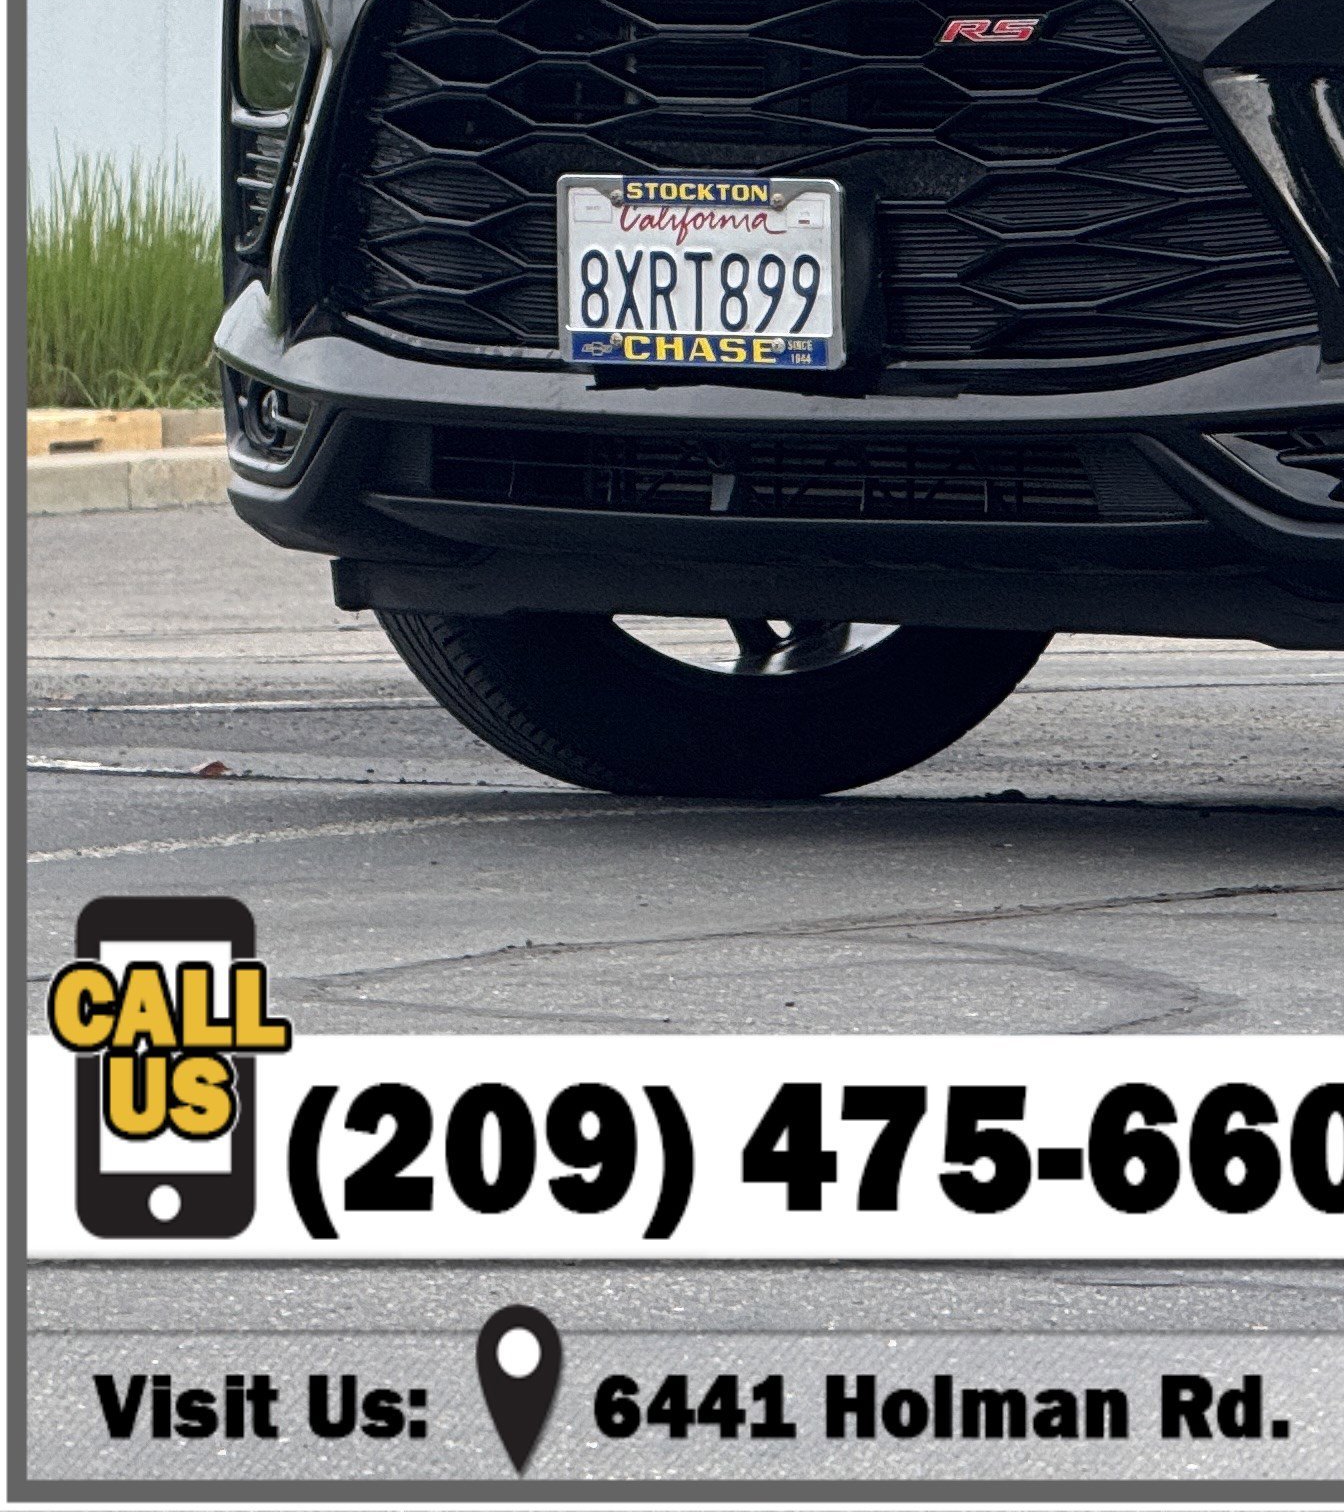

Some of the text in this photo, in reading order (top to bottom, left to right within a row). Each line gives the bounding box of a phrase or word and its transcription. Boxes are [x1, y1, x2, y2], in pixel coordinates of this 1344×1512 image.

[940, 18, 1040, 43] RS
[626, 181, 768, 203] STOCKTON
[619, 205, 788, 246] California
[580, 248, 821, 334] 8XRT899
[623, 335, 777, 364] CHASE
